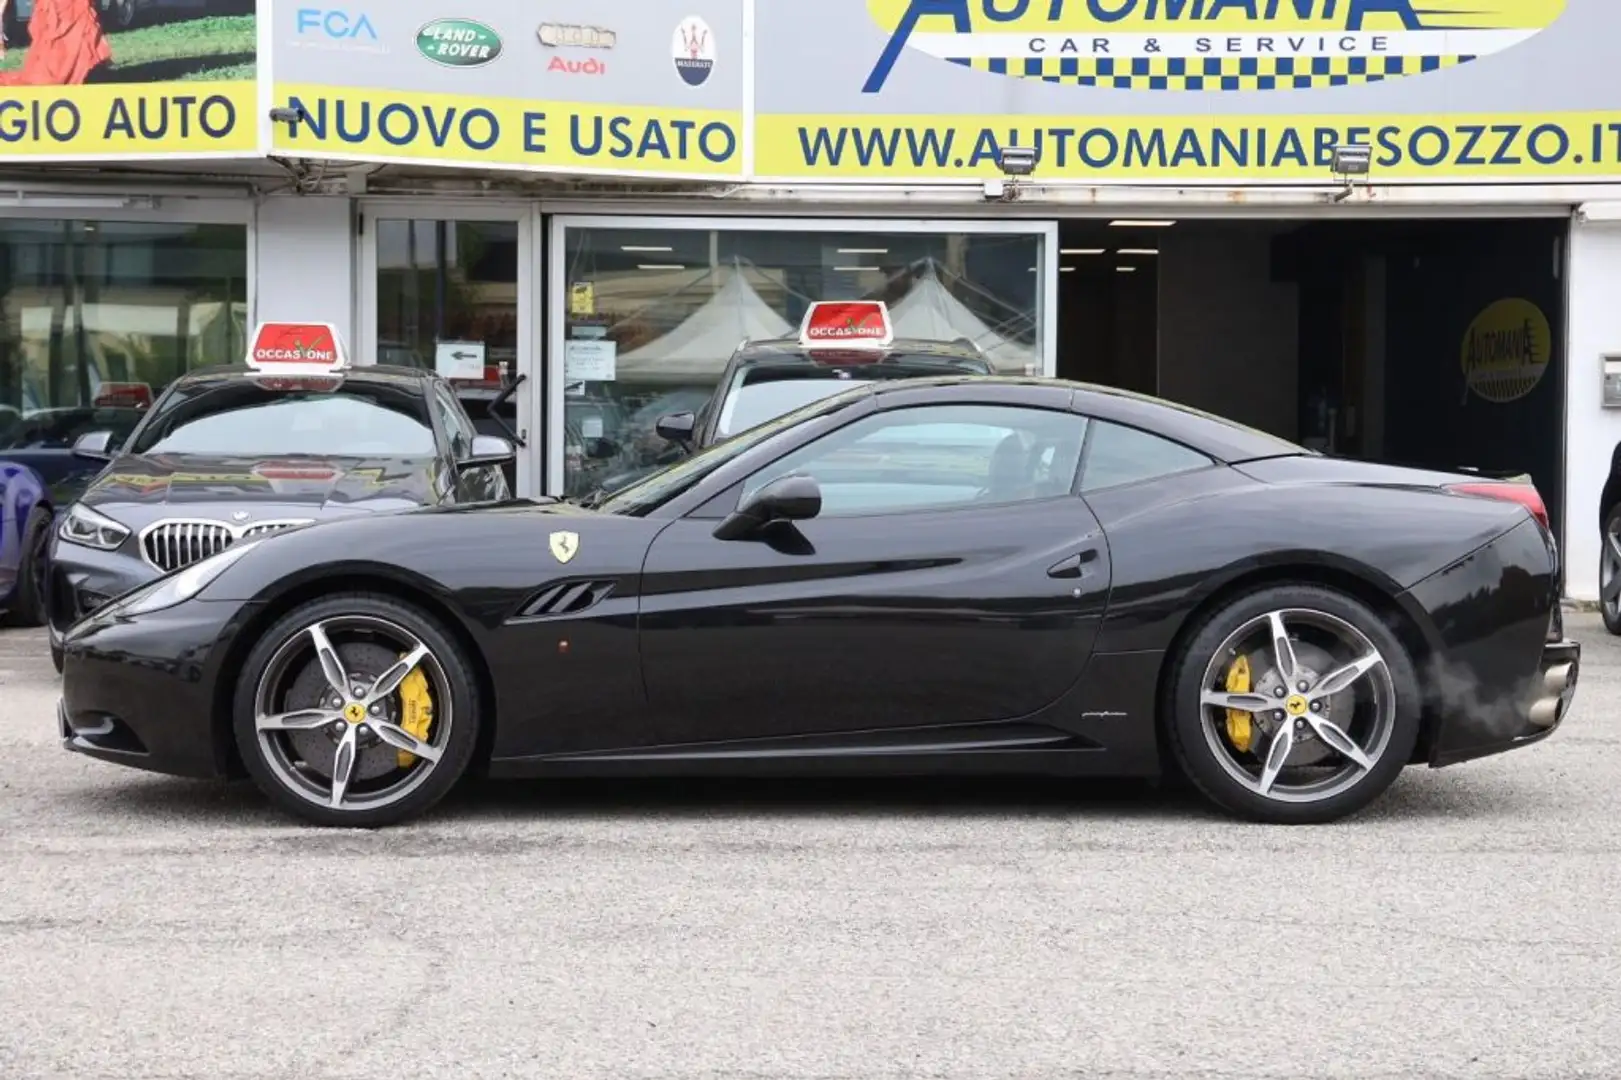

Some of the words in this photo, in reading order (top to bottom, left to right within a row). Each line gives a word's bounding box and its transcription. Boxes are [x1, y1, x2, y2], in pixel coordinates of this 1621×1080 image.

[297, 9, 378, 39] FCA
[433, 27, 477, 43] LAND
[1029, 38, 1110, 53] CAR
[1144, 38, 1161, 53] &
[1196, 36, 1388, 52] SERVICE
[436, 42, 491, 58] ROVER
[547, 55, 606, 74] Audi
[103, 95, 236, 140] AUTO
[288, 97, 500, 150] NUOVO
[523, 112, 547, 153] E
[570, 115, 736, 163] USATO
